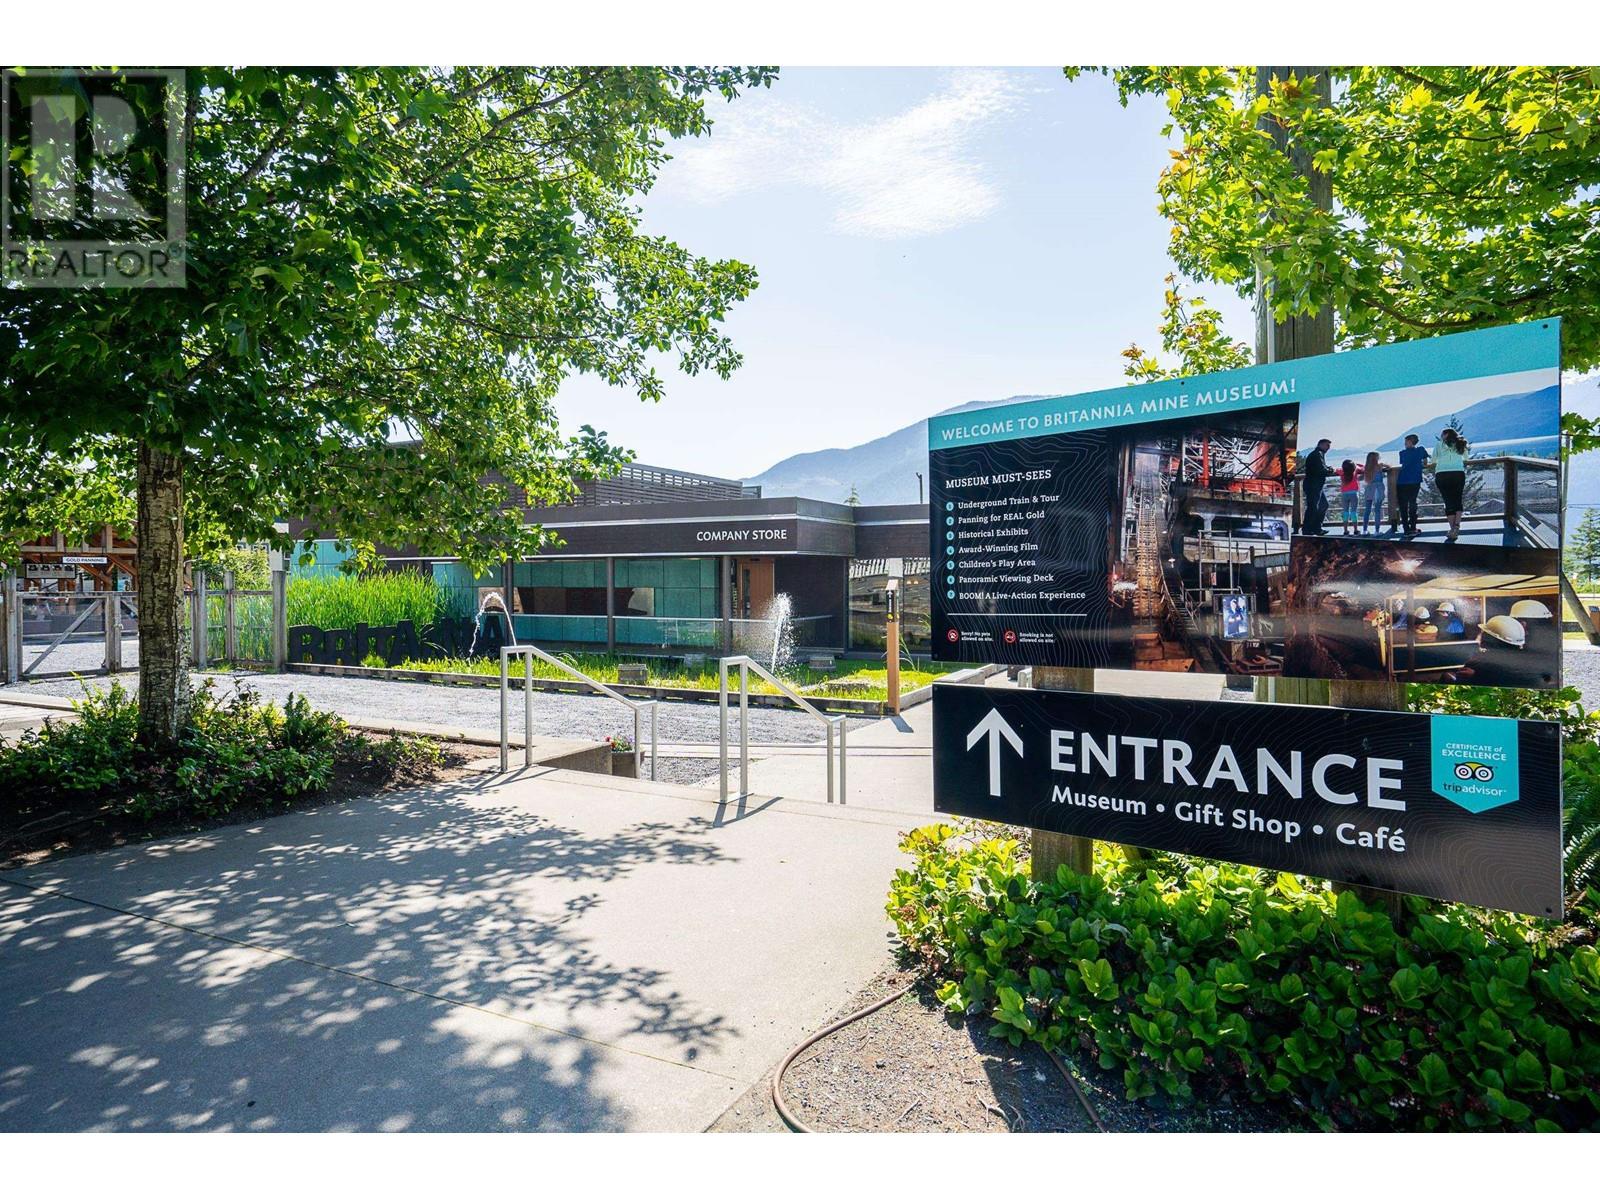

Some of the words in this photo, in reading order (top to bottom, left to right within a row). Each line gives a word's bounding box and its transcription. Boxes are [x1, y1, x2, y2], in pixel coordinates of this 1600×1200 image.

[942, 420, 1014, 440] WELCOME
[1018, 416, 1039, 430] TO
[1044, 403, 1134, 426] BRITANNIA
[1141, 394, 1188, 414] MINE
[1196, 378, 1296, 406] MUSEUM!
[946, 476, 989, 488] MUSEUM
[992, 469, 1052, 484] MUST-SEES
[958, 498, 1007, 510] Underground
[1009, 497, 1030, 505] Train
[958, 515, 988, 524] Panning
[1026, 511, 1045, 519] Gold
[696, 530, 750, 541] COMPANY
[752, 529, 787, 540] STORE
[958, 530, 994, 539] Historical
[996, 528, 1028, 537] Exhibits
[958, 544, 1018, 554] Award-Winning
[958, 560, 996, 568] Children's
[998, 560, 1015, 568] Play
[959, 575, 998, 584] Panoramic
[1000, 574, 1032, 583] Viewing
[1039, 592, 1086, 601] Experience
[1446, 743, 1492, 752] CERTIFICATE
[1442, 749, 1507, 761] EXCELLENCE
[1050, 729, 1406, 812] ENTRANCE
[1052, 784, 1147, 816] Museum
[1174, 801, 1224, 827] Gift
[1232, 808, 1302, 843] Shop
[1336, 822, 1406, 853] Café
